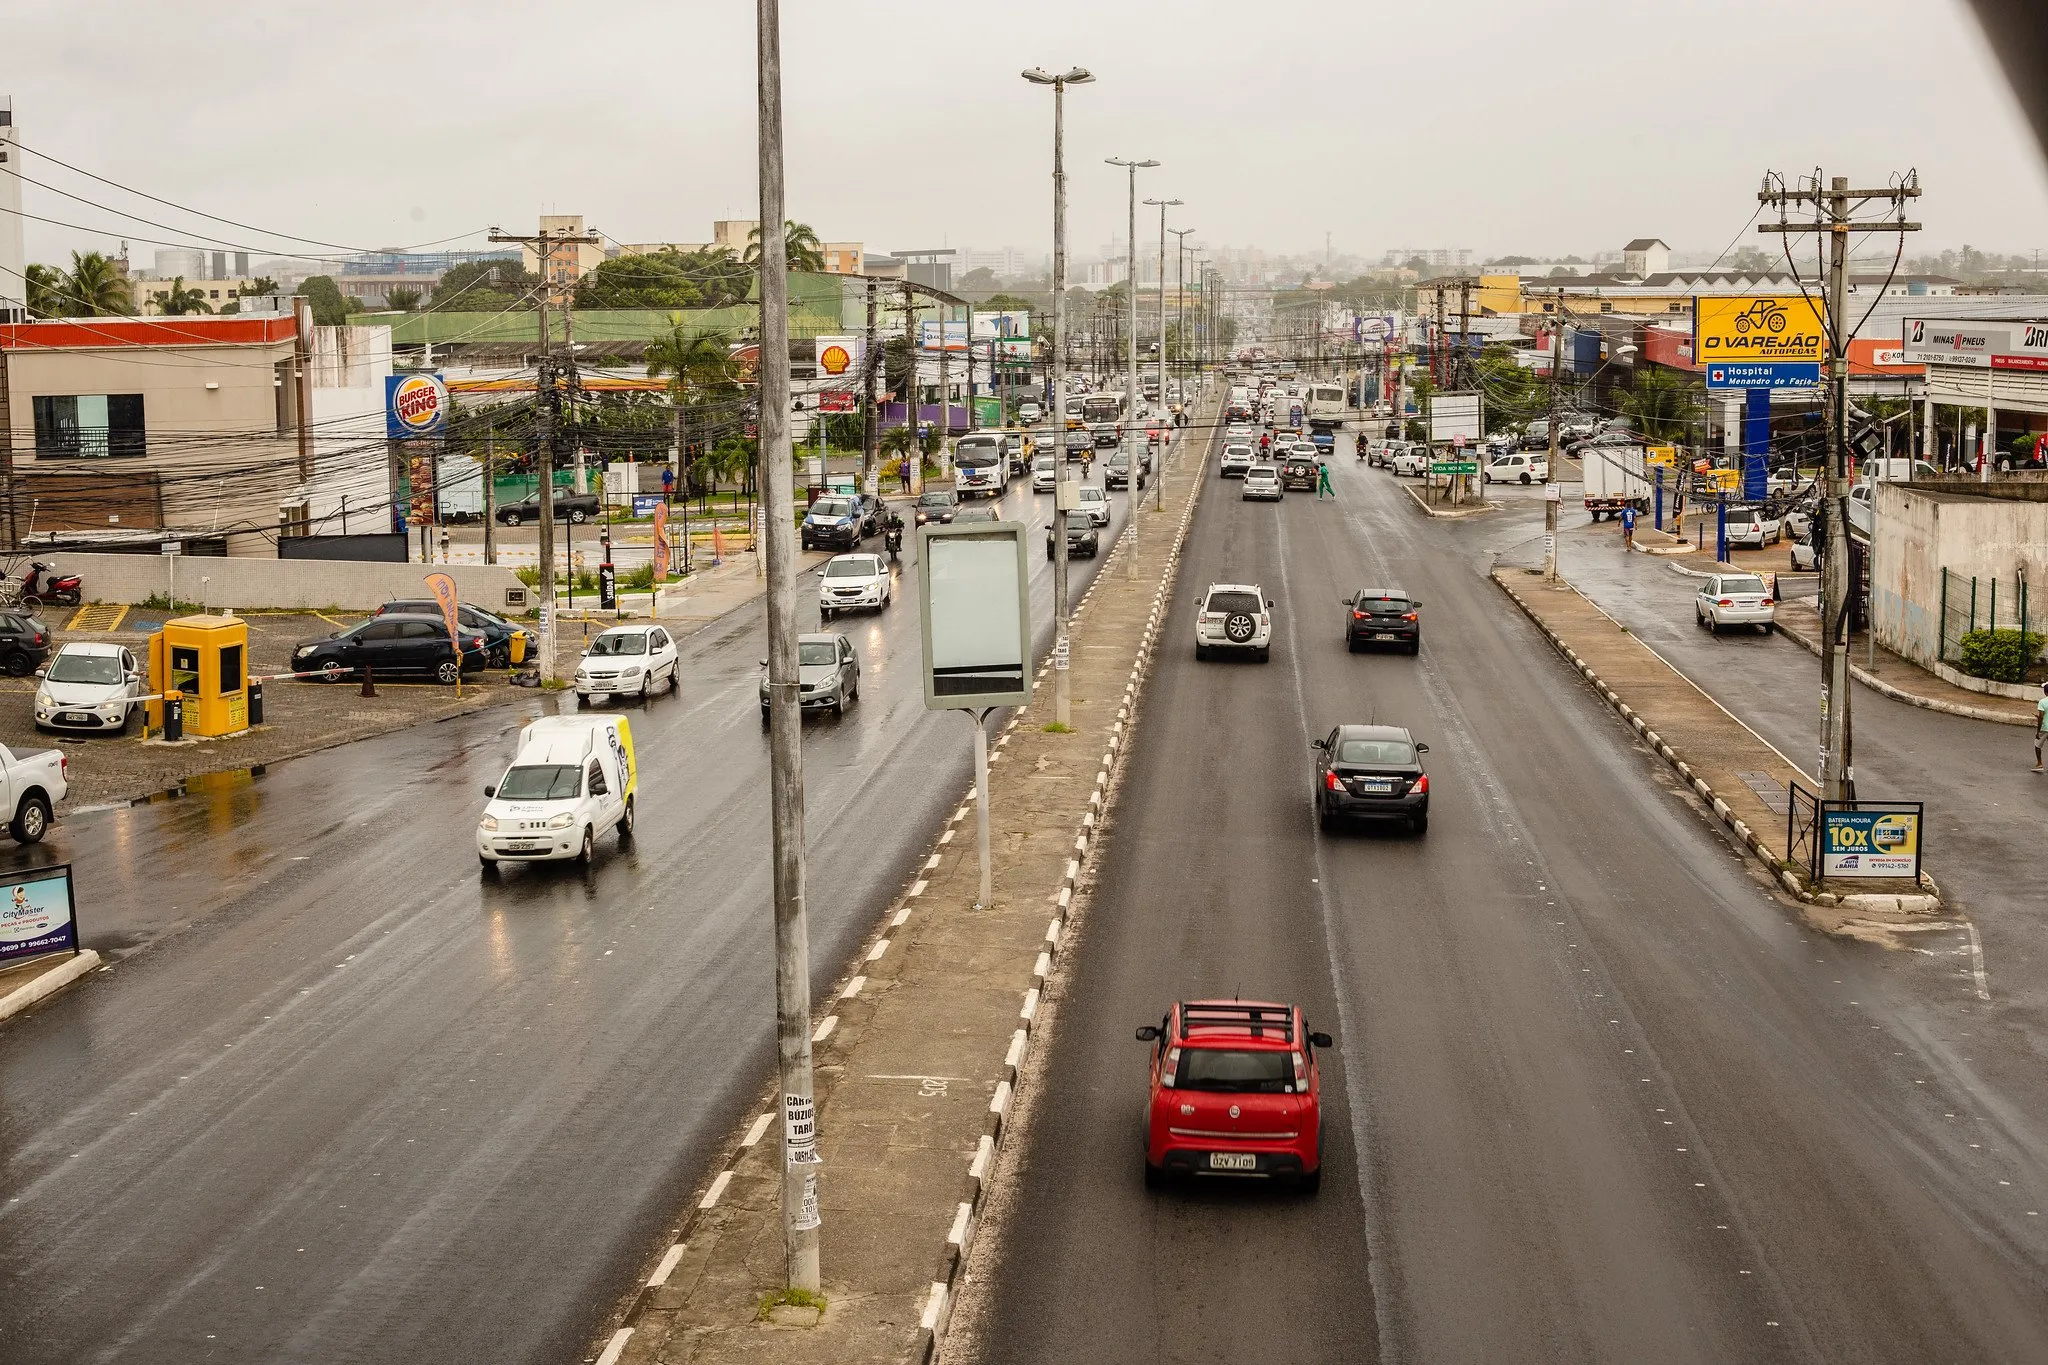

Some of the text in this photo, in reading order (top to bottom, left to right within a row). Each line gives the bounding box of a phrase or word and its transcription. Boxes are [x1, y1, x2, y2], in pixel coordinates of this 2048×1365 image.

[1705, 337, 1721, 348] O
[1725, 332, 1820, 348] VAREJÃO
[1932, 335, 1986, 346] MINAS PNEUS
[1728, 367, 1773, 377] Hospital
[1728, 377, 1812, 386] Menandro de Faria
[399, 386, 436, 407] BURGER
[401, 395, 438, 420] KING
[605, 580, 614, 600] SAÍDA
[1829, 827, 1868, 846] 10x
[3, 906, 45, 919] CityMaster
[22, 916, 50, 924] PRODUTOS
[28, 935, 66, 948] 99662-7047
[793, 1122, 813, 1135] TARÔ
